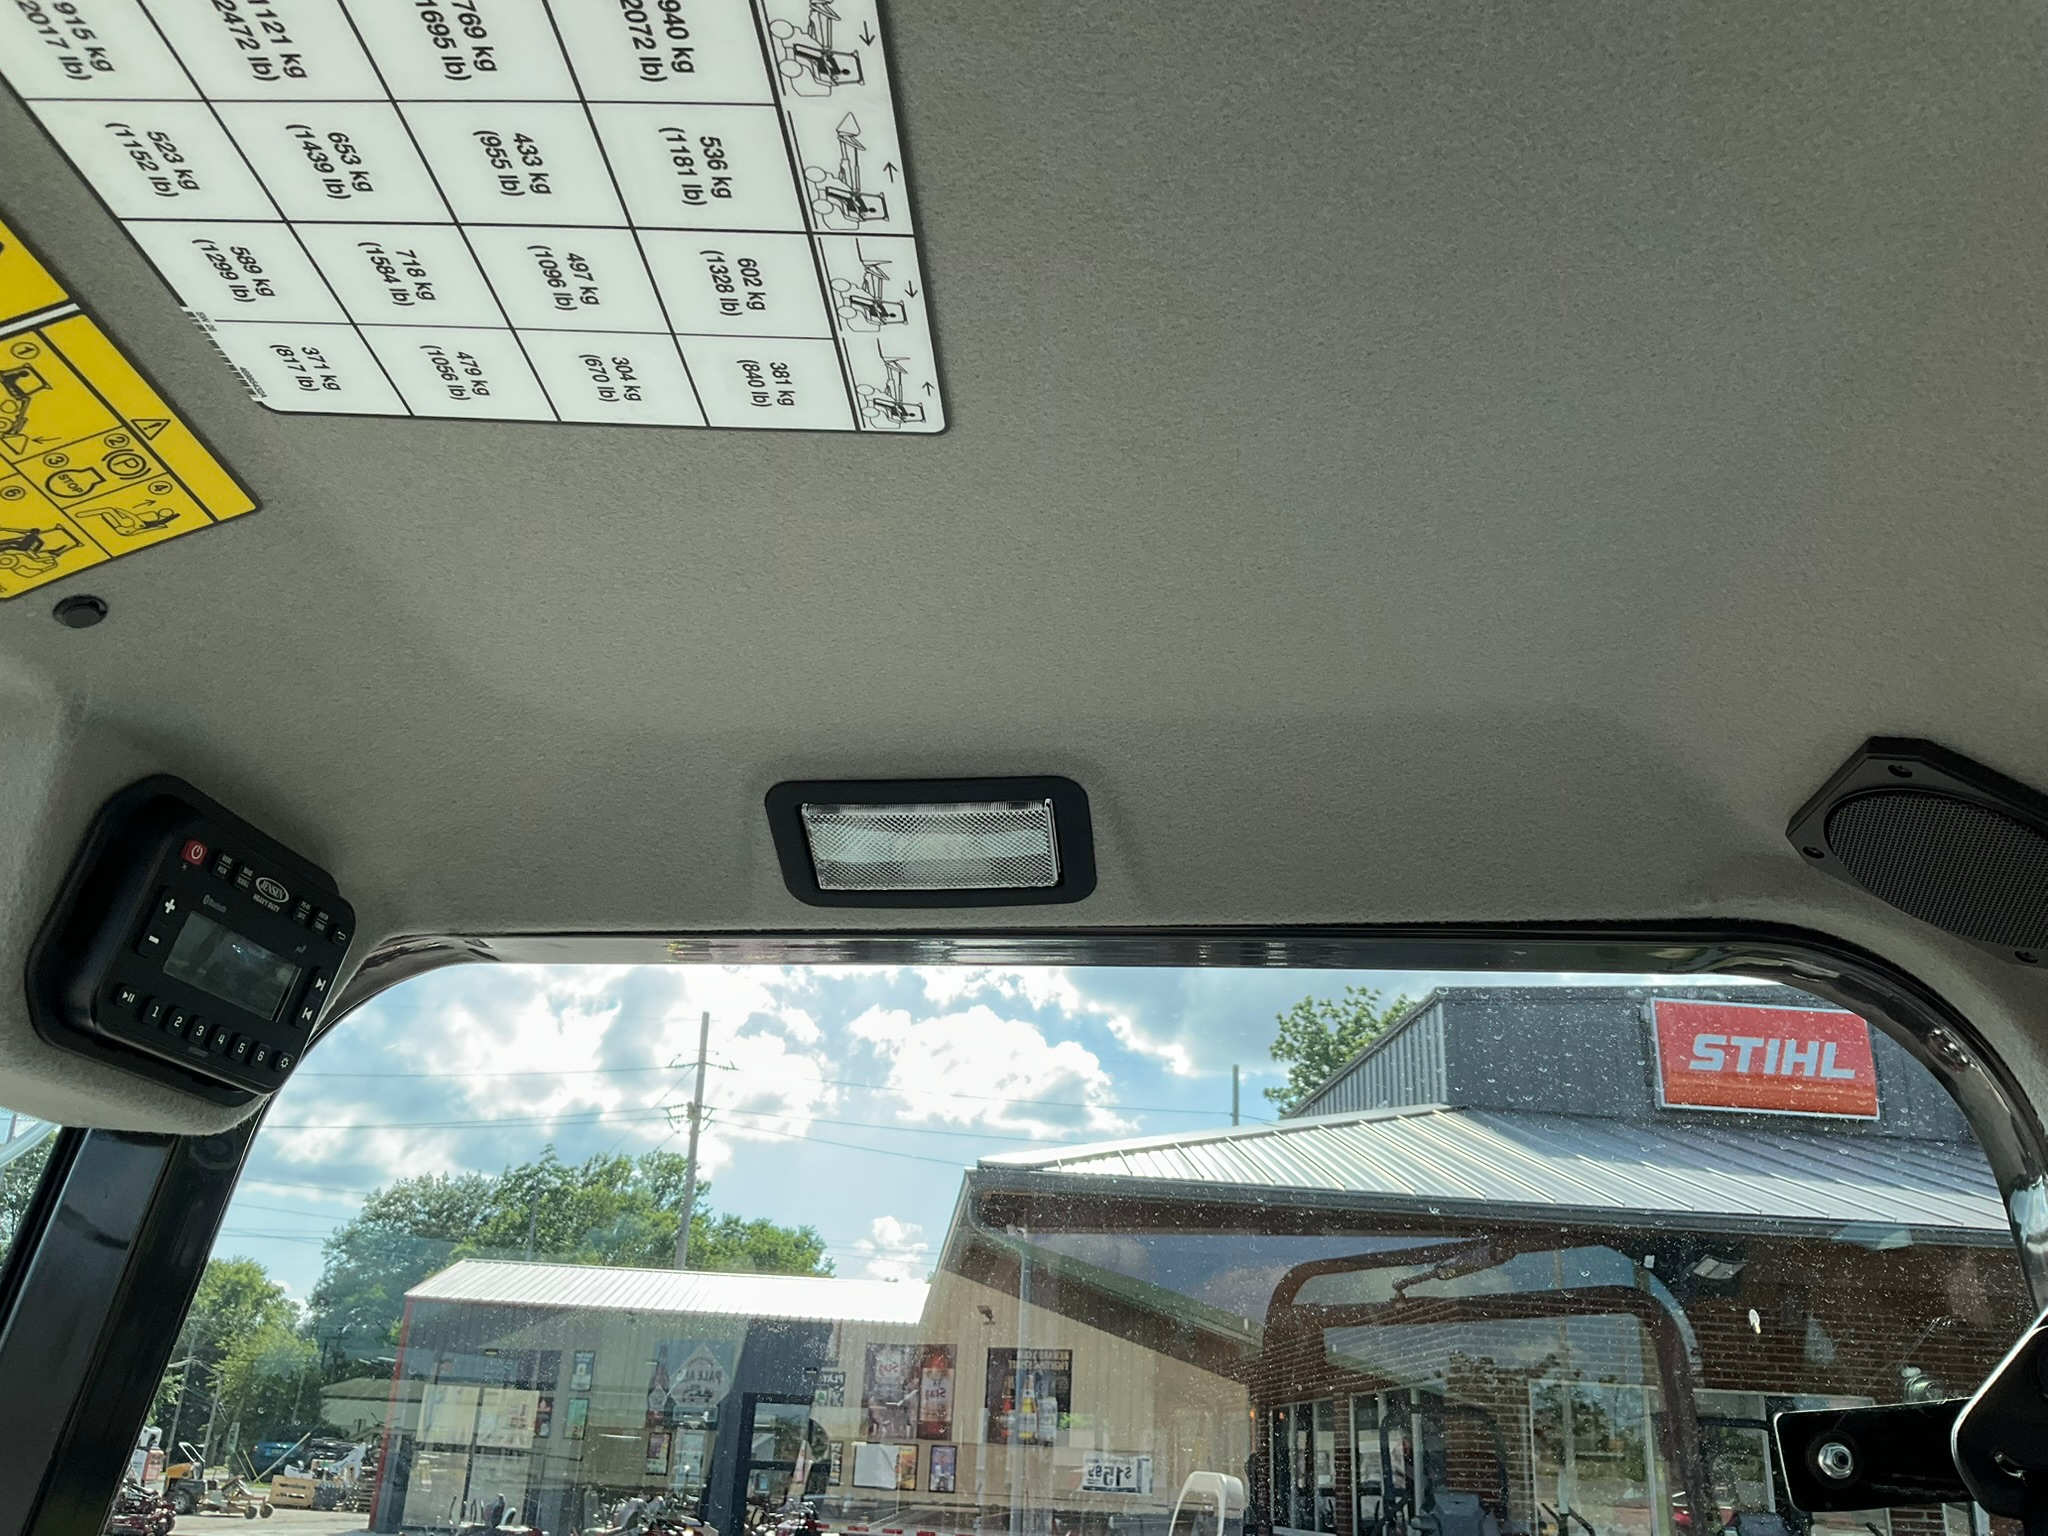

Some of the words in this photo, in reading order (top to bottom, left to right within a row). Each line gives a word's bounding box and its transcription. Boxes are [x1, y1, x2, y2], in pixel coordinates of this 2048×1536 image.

[656, 0, 690, 41] 940
[52, 1, 98, 41] 915
[83, 46, 116, 72] kg
[246, 0, 294, 44] 1121
[278, 53, 308, 79] kg
[450, 0, 488, 40] 769
[470, 45, 498, 72] kg
[57, 55, 93, 81] lb)
[246, 56, 282, 82] lb)
[440, 55, 473, 82] lb)
[638, 56, 669, 83] lb)
[670, 46, 696, 74] kg
[104, 122, 160, 172] (1152
[147, 176, 180, 198] lb)
[146, 130, 185, 164] 523
[172, 168, 201, 191] kg
[284, 123, 336, 174] (1439
[321, 178, 352, 200] lb)
[326, 131, 362, 166] 653
[348, 170, 375, 193] kg
[472, 130, 514, 170] (955
[497, 174, 526, 197] lb)
[512, 132, 544, 167] 433
[698, 135, 729, 171] 536
[657, 126, 699, 177] (1181
[681, 183, 708, 206] lb)
[527, 172, 553, 195] kg
[709, 176, 733, 199] kg
[191, 238, 240, 281] (1299
[228, 284, 257, 303] lb)
[229, 245, 263, 275] 589
[251, 278, 276, 297] kg
[357, 241, 403, 285] (1584
[388, 287, 416, 307] lb)
[395, 249, 427, 278] 718
[413, 281, 437, 301] kg
[526, 244, 568, 289] (1096
[552, 292, 579, 311] lb)
[565, 252, 595, 282] 497
[736, 257, 764, 288] 602
[578, 286, 601, 306] kg
[699, 249, 736, 294] (1328
[719, 297, 744, 317] lb)
[745, 291, 767, 311] kg
[269, 344, 308, 373] (817
[294, 375, 321, 392] lb)
[300, 346, 331, 370] 371
[319, 374, 342, 391] kg
[419, 344, 460, 382] (1056
[446, 384, 472, 401] lb)
[455, 351, 483, 377] 479
[470, 379, 491, 397] kg
[578, 353, 611, 383] (670
[596, 386, 621, 403] lb)
[610, 356, 638, 382] 304
[736, 359, 766, 389] (840
[769, 361, 793, 385] 381
[622, 384, 643, 402] kg
[750, 391, 773, 408] lb)
[776, 389, 796, 407] kg
[58, 473, 84, 495] STOP
[253, 893, 269, 906] HEAVY
[260, 880, 285, 899] JENSEN
[151, 1006, 160, 1018] 1
[174, 1016, 183, 1028] 2
[196, 1025, 205, 1036] 3
[218, 1034, 226, 1045] 4
[237, 1042, 246, 1053] 5
[257, 1051, 265, 1061] 6
[1689, 1033, 1855, 1079] STIHL
